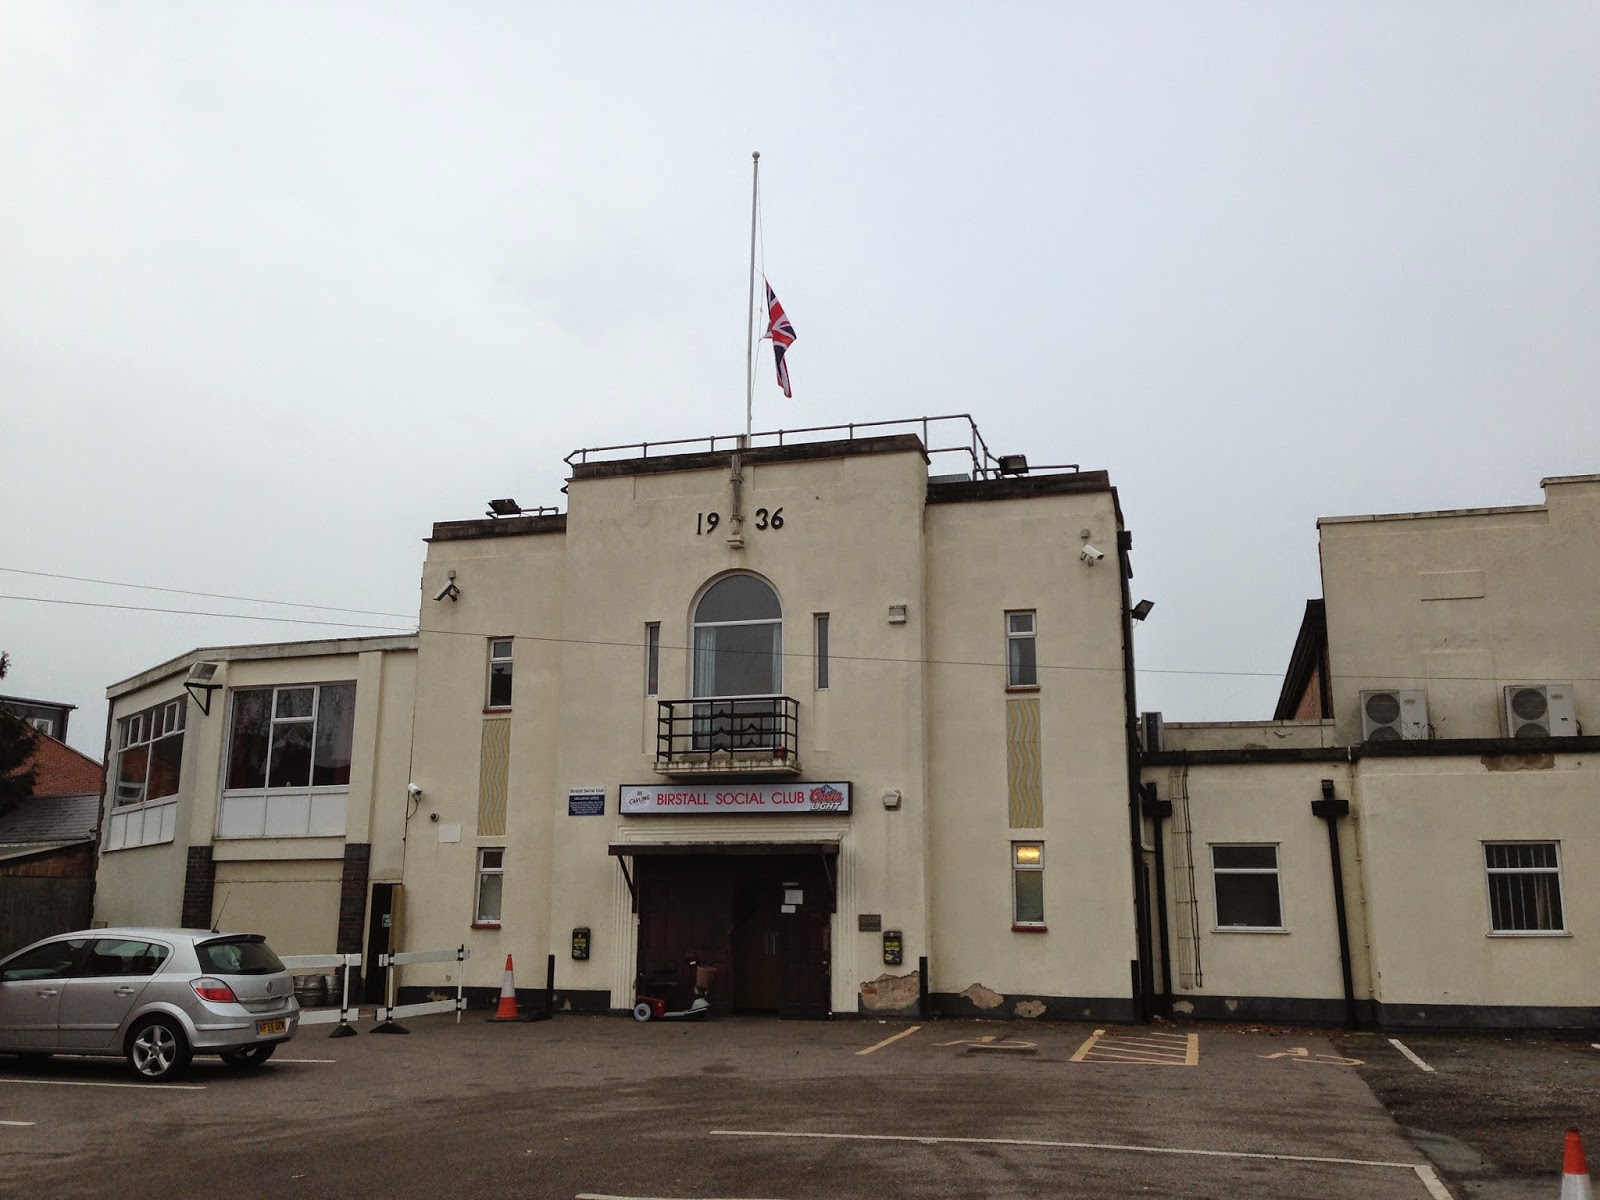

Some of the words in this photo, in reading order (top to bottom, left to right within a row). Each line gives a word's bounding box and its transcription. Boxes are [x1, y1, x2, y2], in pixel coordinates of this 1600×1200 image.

[697, 512, 720, 535] 19
[755, 506, 784, 531] 36
[628, 794, 651, 805] CARLING
[656, 793, 709, 805] BIRSTALL
[715, 792, 765, 805] SOCIAL
[771, 791, 805, 804] CLUB
[810, 802, 841, 811] LIGHT
